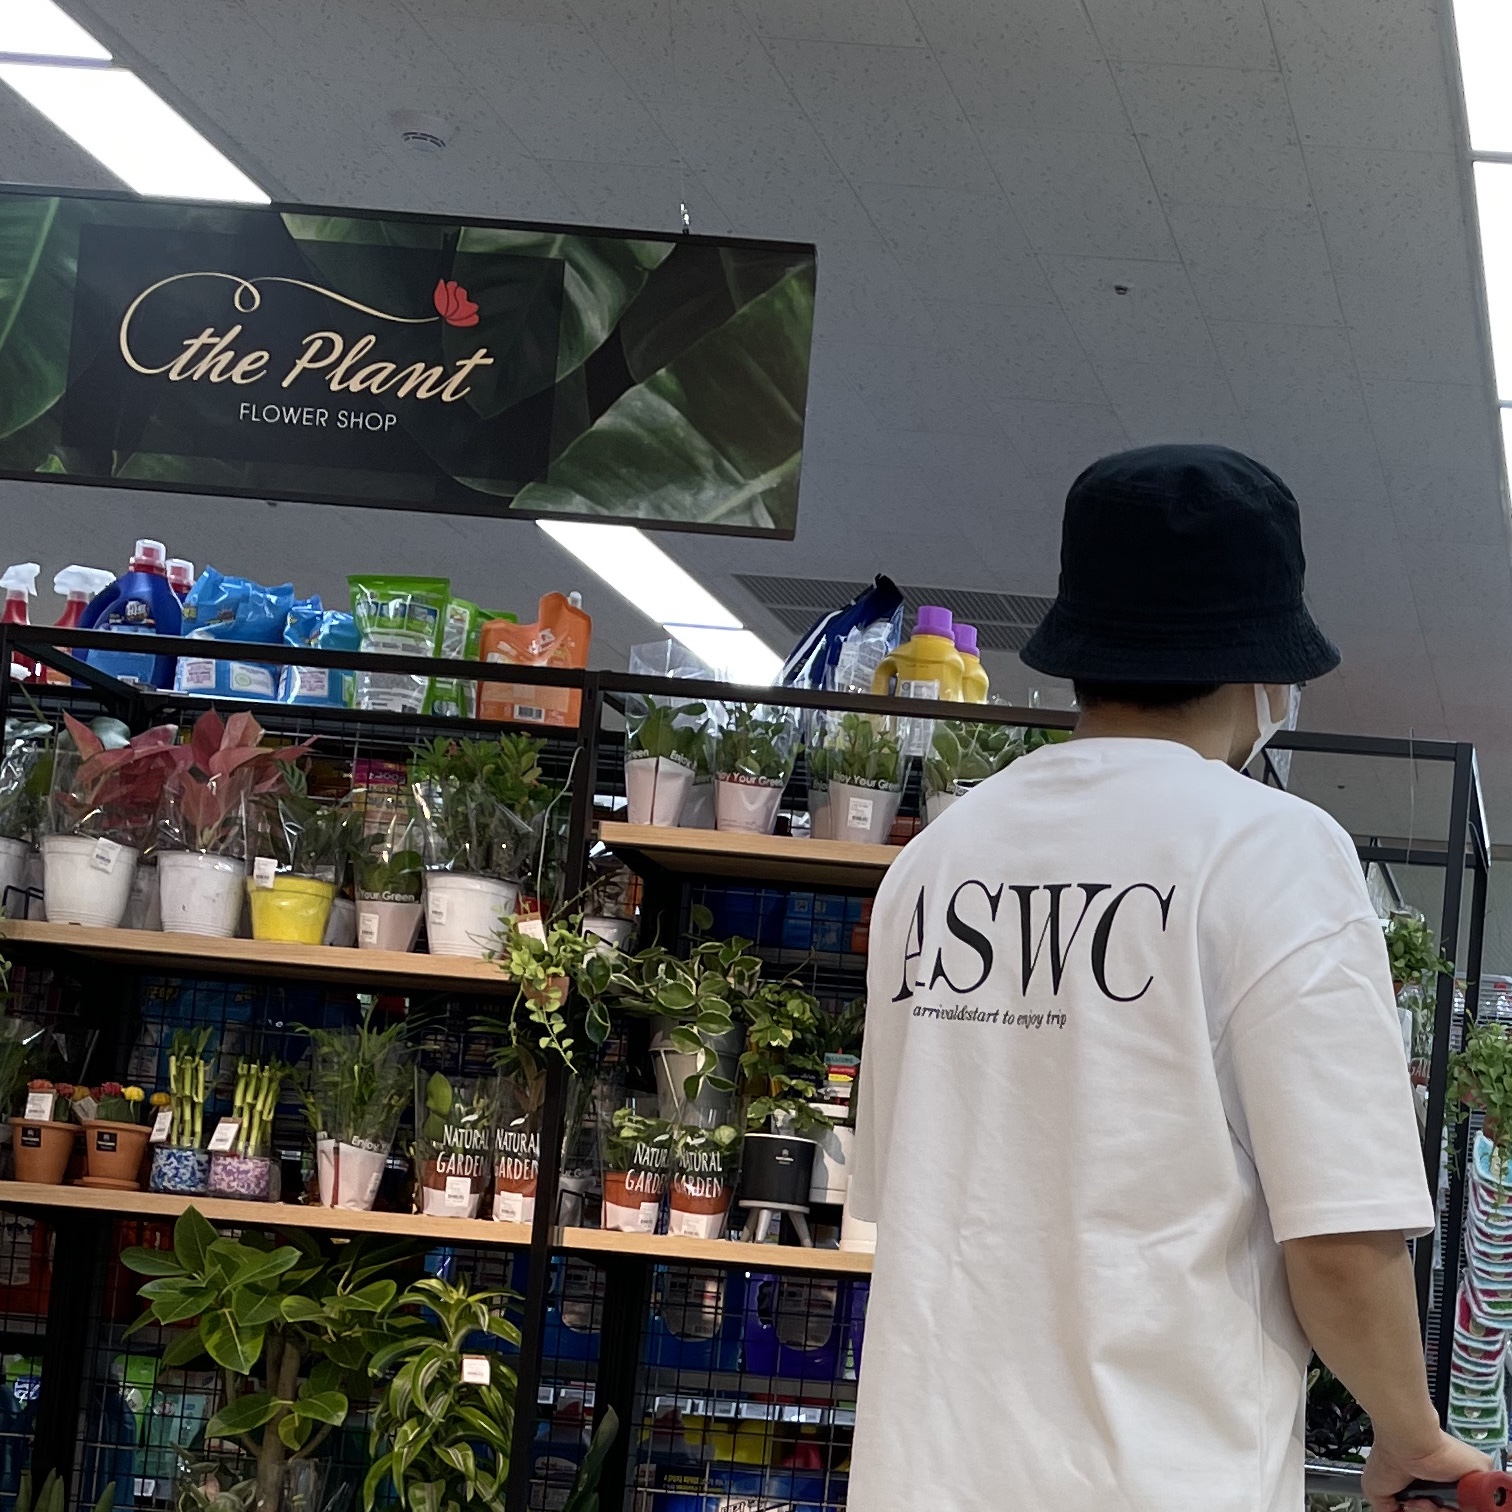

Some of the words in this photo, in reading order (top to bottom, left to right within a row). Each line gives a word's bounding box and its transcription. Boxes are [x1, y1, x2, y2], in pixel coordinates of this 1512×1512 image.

[166, 324, 271, 385] the
[280, 330, 495, 403] Plant
[238, 402, 329, 428] FLOWER
[336, 409, 398, 433] SHOP
[733, 772, 757, 785] Your
[853, 774, 876, 788] Your
[381, 890, 415, 903] Green
[891, 879, 1177, 1003] ASWC
[1001, 1009, 1015, 1025] to
[1016, 1010, 1043, 1030] enjoy
[1045, 1008, 1067, 1030] trip
